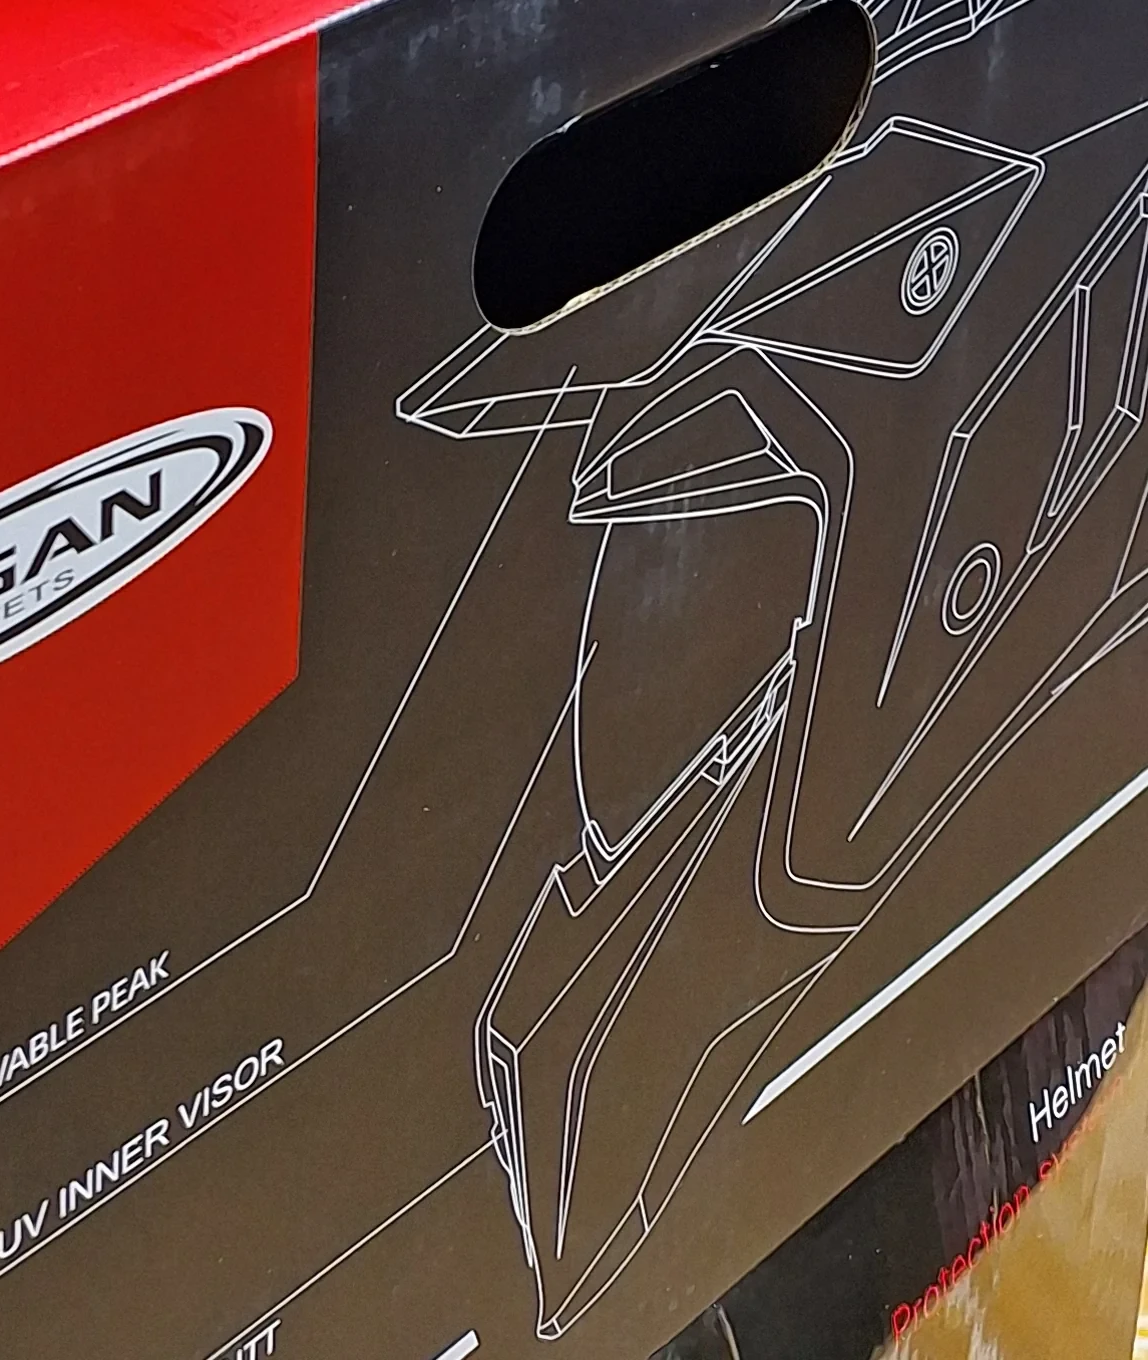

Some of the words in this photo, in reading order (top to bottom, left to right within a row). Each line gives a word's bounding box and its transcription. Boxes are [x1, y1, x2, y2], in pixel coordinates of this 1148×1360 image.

[91, 951, 169, 1024] PEAK
[57, 1118, 170, 1218] INNER
[177, 1037, 286, 1129] VISOR
[1030, 1022, 1126, 1142] Helmet
[892, 1186, 1030, 1342] Protection
